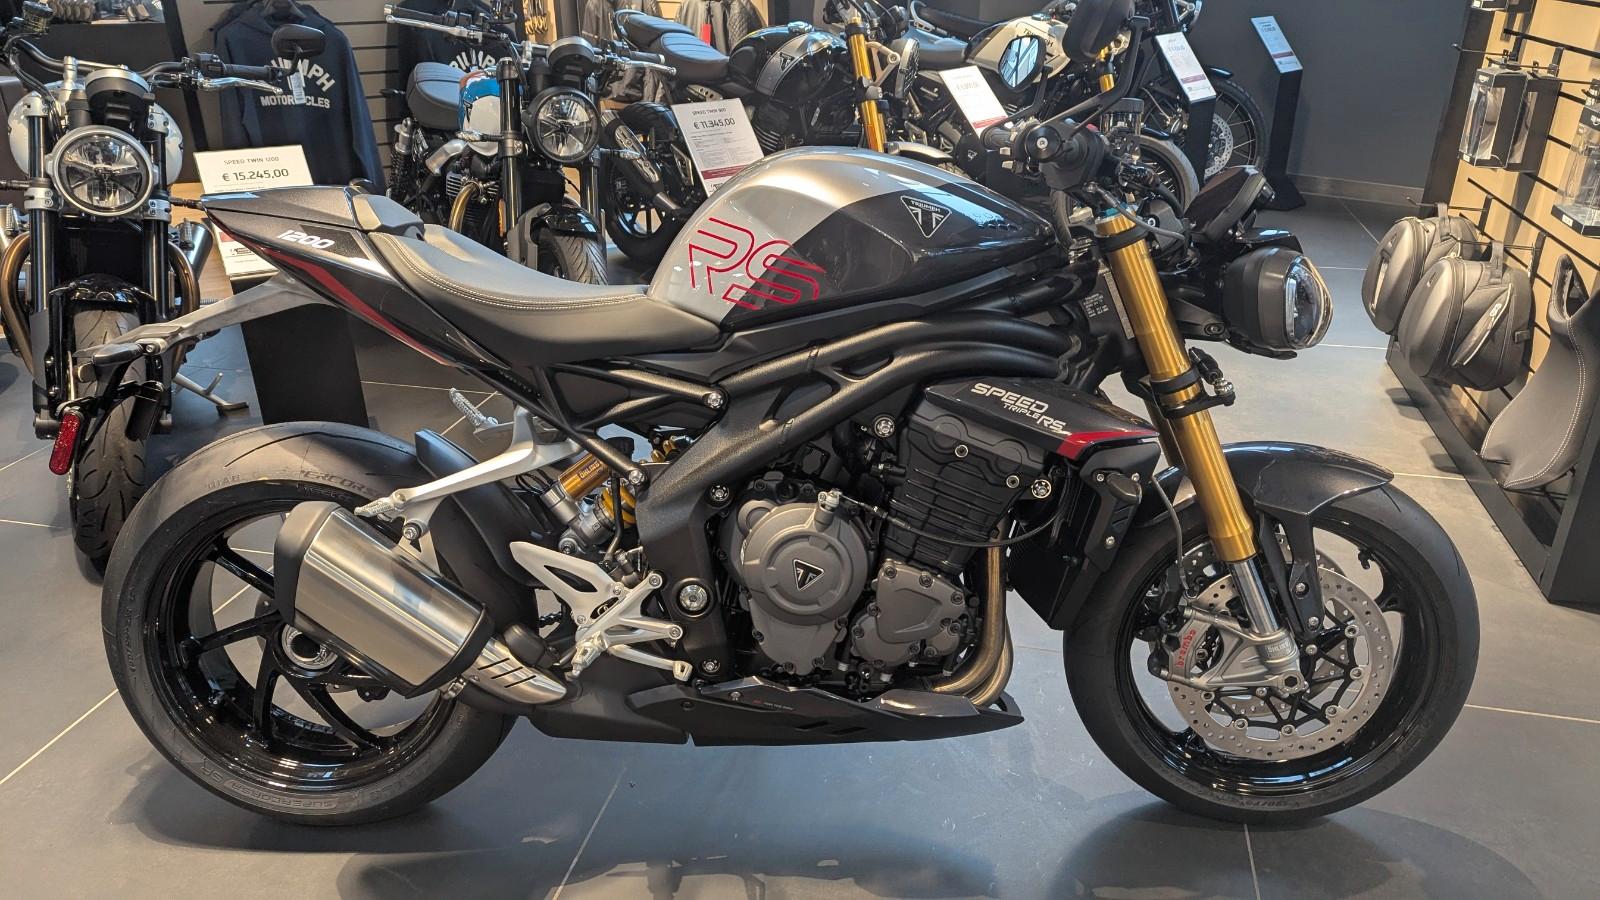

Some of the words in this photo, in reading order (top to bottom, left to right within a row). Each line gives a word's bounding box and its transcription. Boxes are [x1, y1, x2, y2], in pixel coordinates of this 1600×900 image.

[260, 95, 330, 109] MOTORCLES
[693, 121, 699, 129] €
[222, 173, 230, 181] €
[233, 168, 289, 181] 15.245,00
[277, 229, 335, 249] 1200
[689, 217, 826, 311] RS
[971, 382, 1049, 413] SPEED
[1003, 402, 1041, 419] TRIPLE
[1036, 414, 1068, 434] RS
[1174, 629, 1197, 668] brembo
